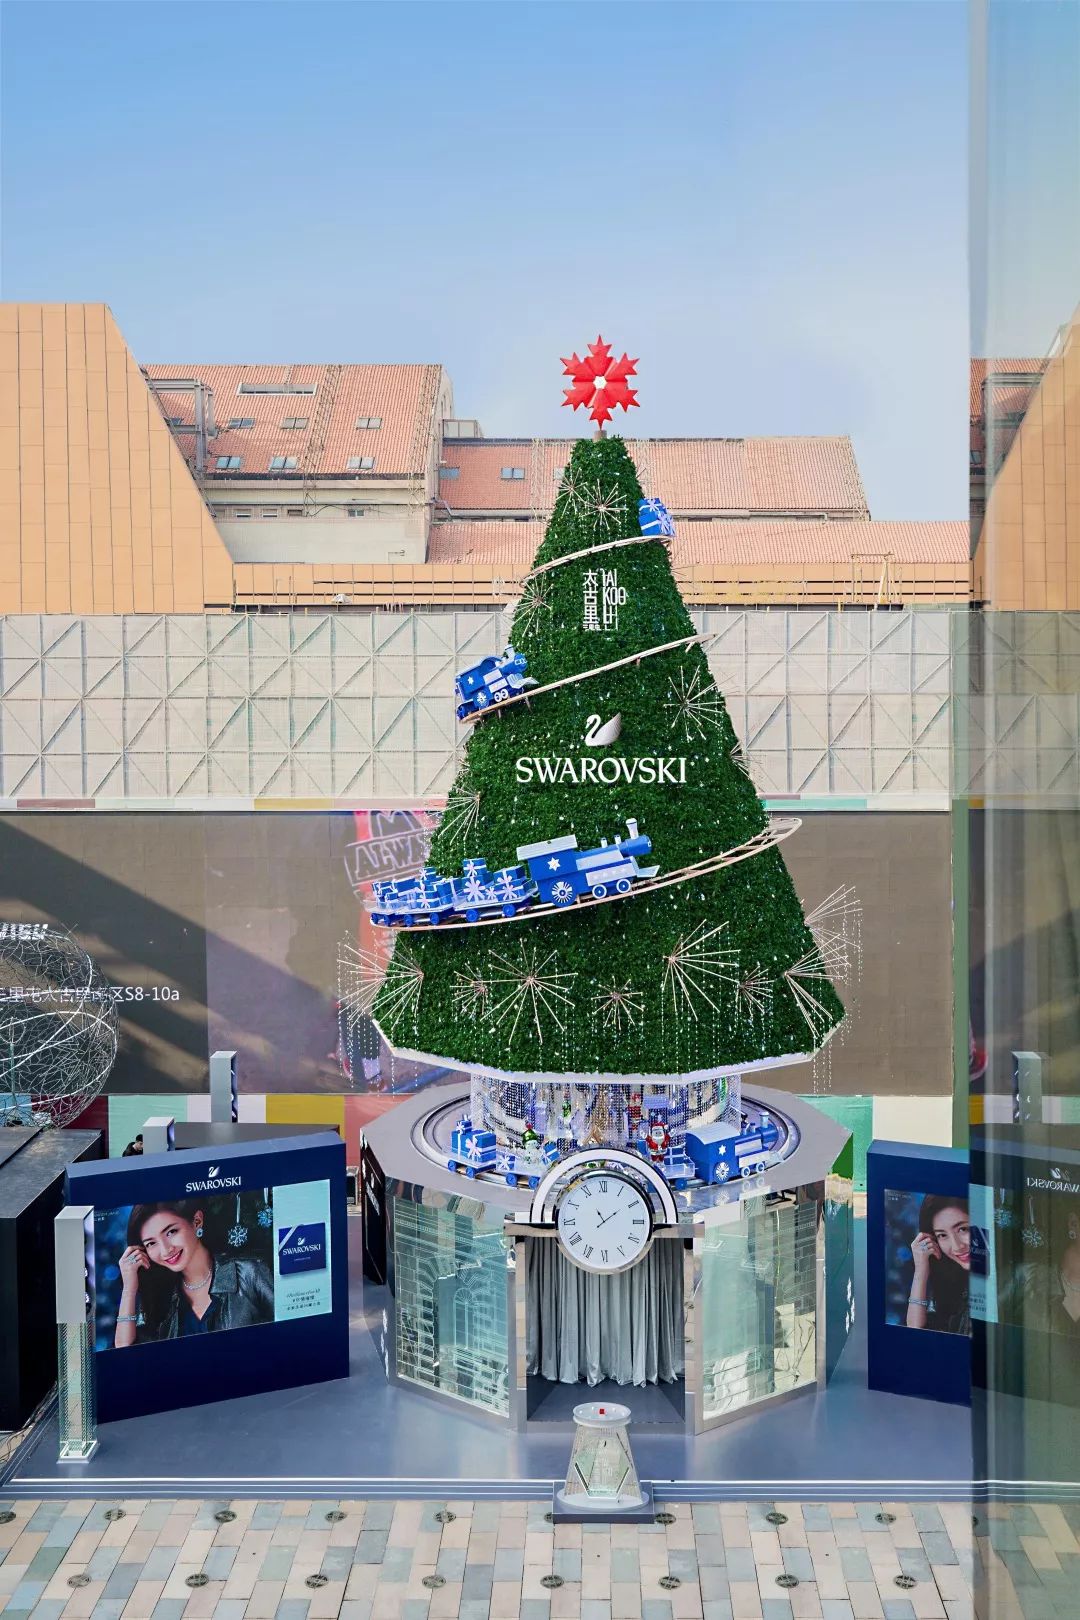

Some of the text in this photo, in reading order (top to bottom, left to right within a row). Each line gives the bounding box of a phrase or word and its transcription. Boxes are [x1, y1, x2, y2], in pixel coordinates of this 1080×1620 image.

[582, 568, 599, 624] 太古里
[515, 756, 688, 784] SWAROVSKI
[185, 1175, 242, 1193] SWAROVSKI
[599, 1181, 608, 1193] XII
[282, 1243, 321, 1256] SWAROVSKI
